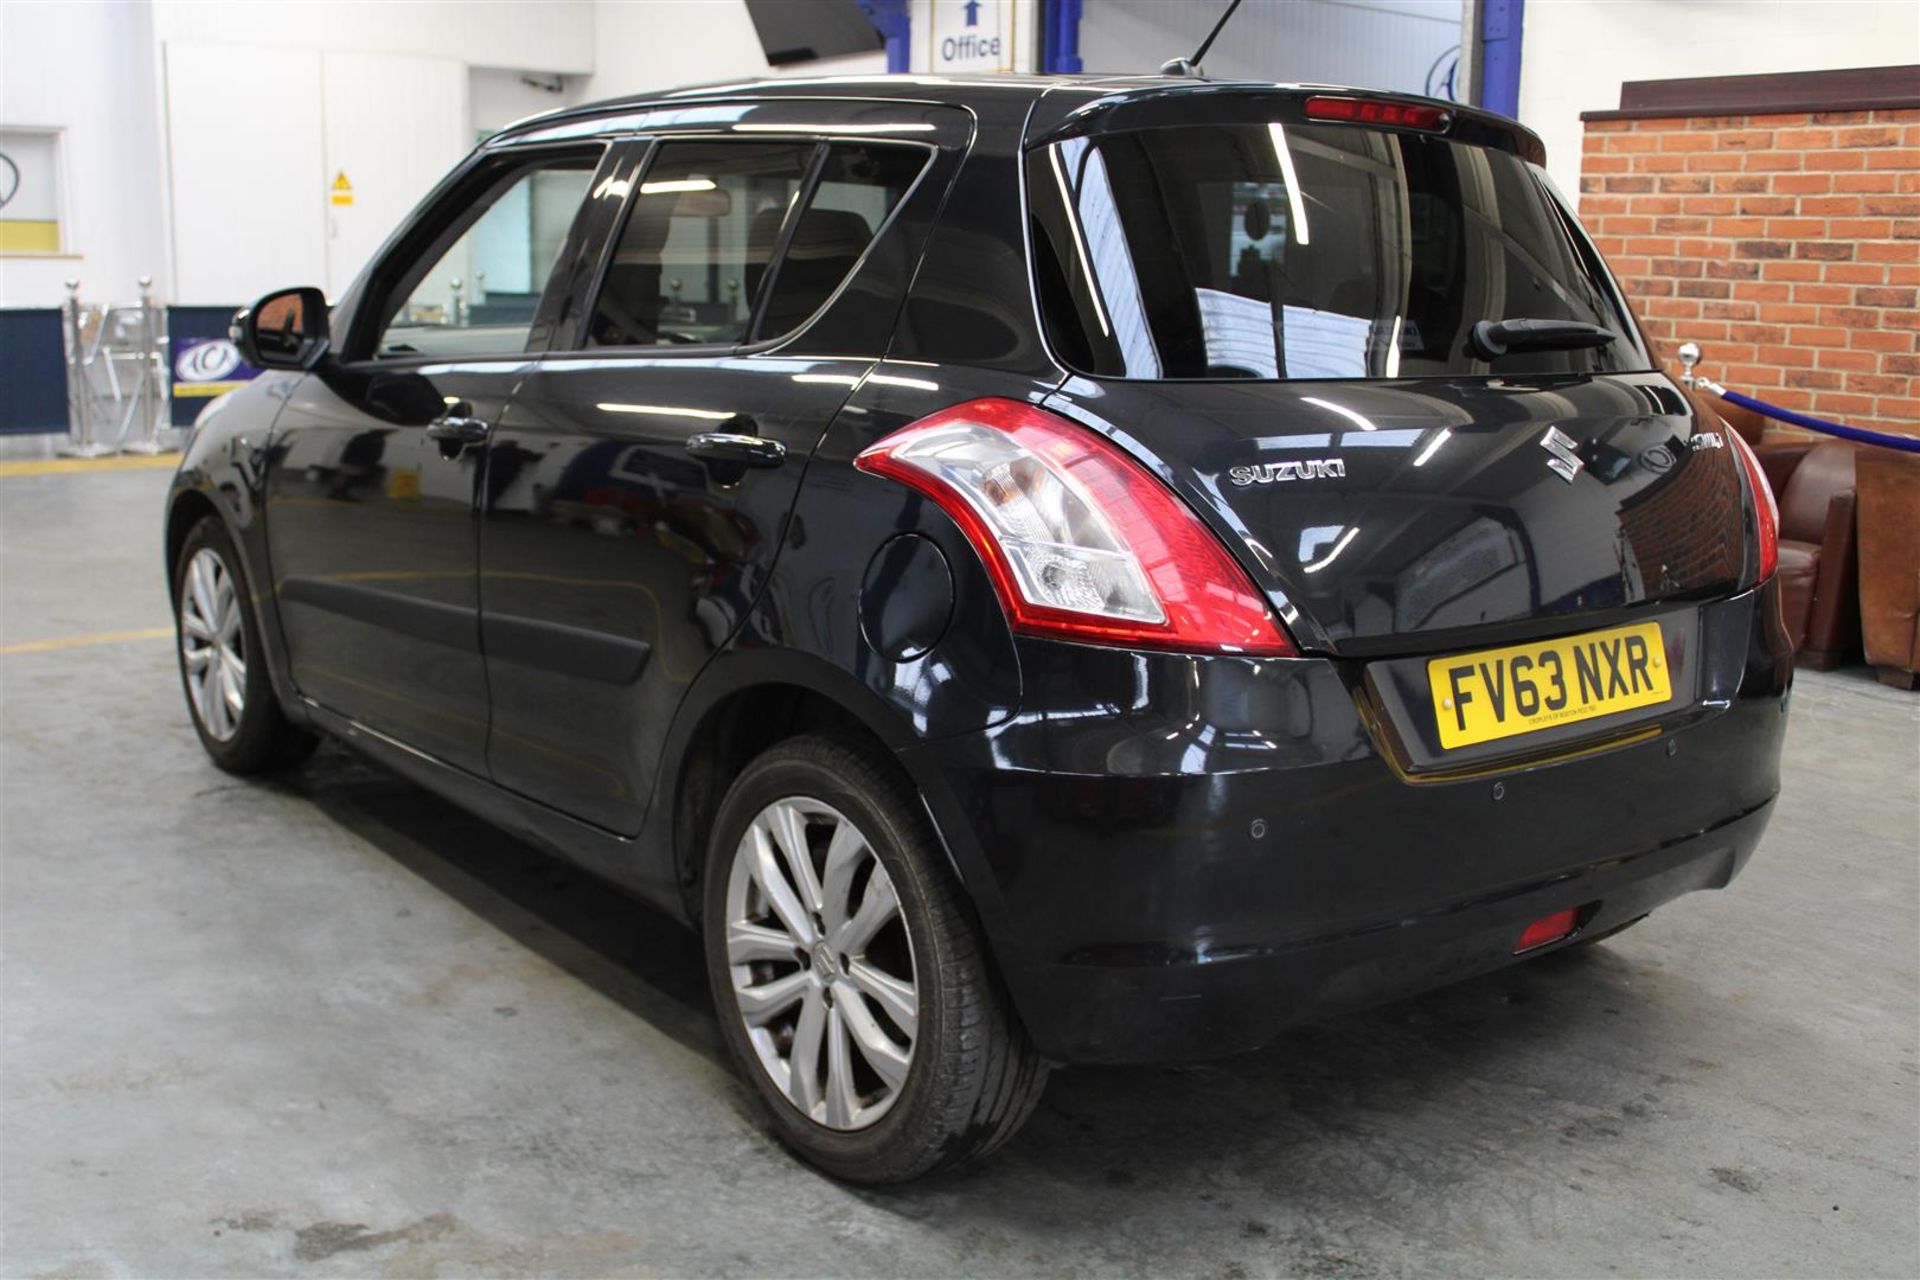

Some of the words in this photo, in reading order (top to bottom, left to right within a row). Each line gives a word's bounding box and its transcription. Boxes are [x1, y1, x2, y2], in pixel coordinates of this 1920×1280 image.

[942, 35, 1000, 61] Office
[1229, 458, 1346, 486] SUZUKI
[1448, 650, 1568, 731] FV63
[1573, 634, 1654, 704] NXR
